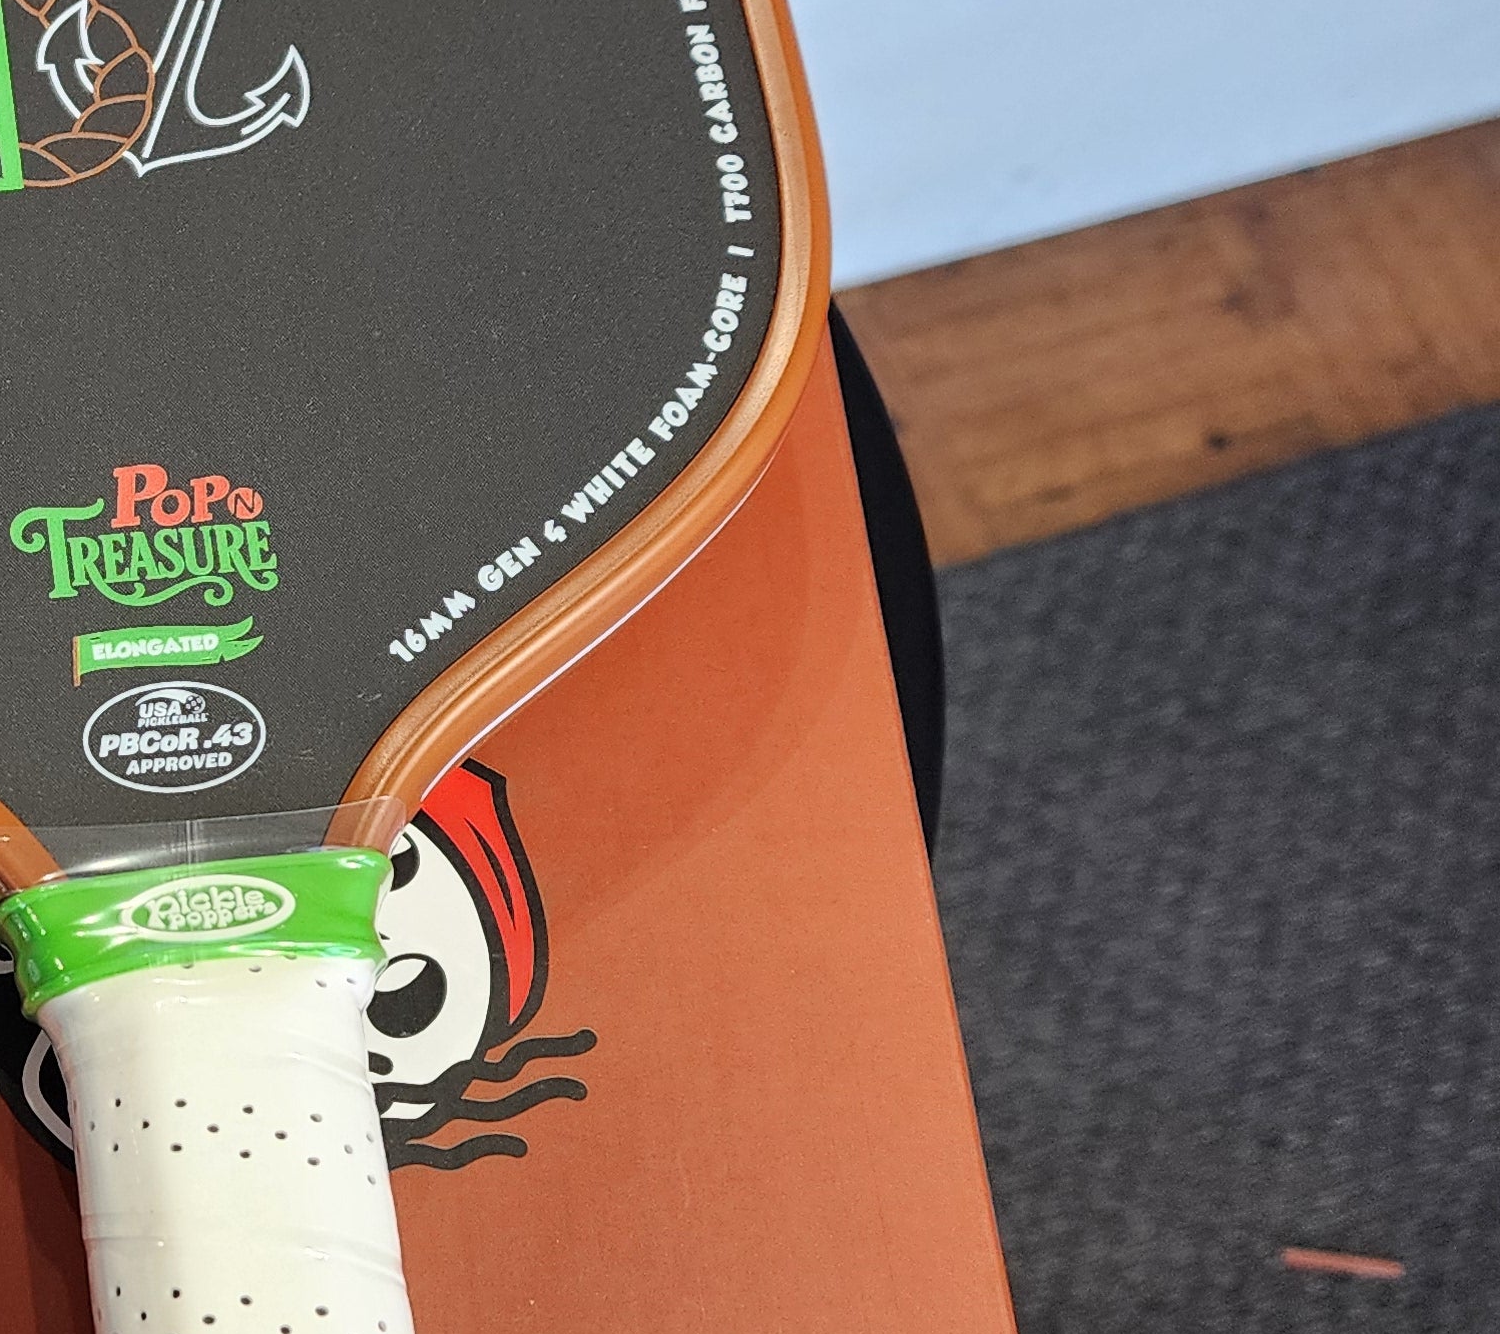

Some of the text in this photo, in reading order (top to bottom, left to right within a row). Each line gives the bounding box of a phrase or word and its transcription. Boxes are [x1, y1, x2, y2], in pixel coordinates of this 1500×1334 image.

[686, 24, 740, 145] CARBON
[716, 153, 754, 224] T700
[648, 271, 749, 442] FOAM-CORE
[560, 437, 657, 524] WHITE
[543, 518, 568, 544] 4
[477, 536, 542, 593] GEN
[91, 632, 220, 662] ELONGATED
[388, 589, 476, 663] 16MM
[136, 712, 209, 728] PICKLEBALL
[138, 701, 183, 718] USA
[202, 721, 254, 750] .43
[125, 751, 234, 776] APPROVED
